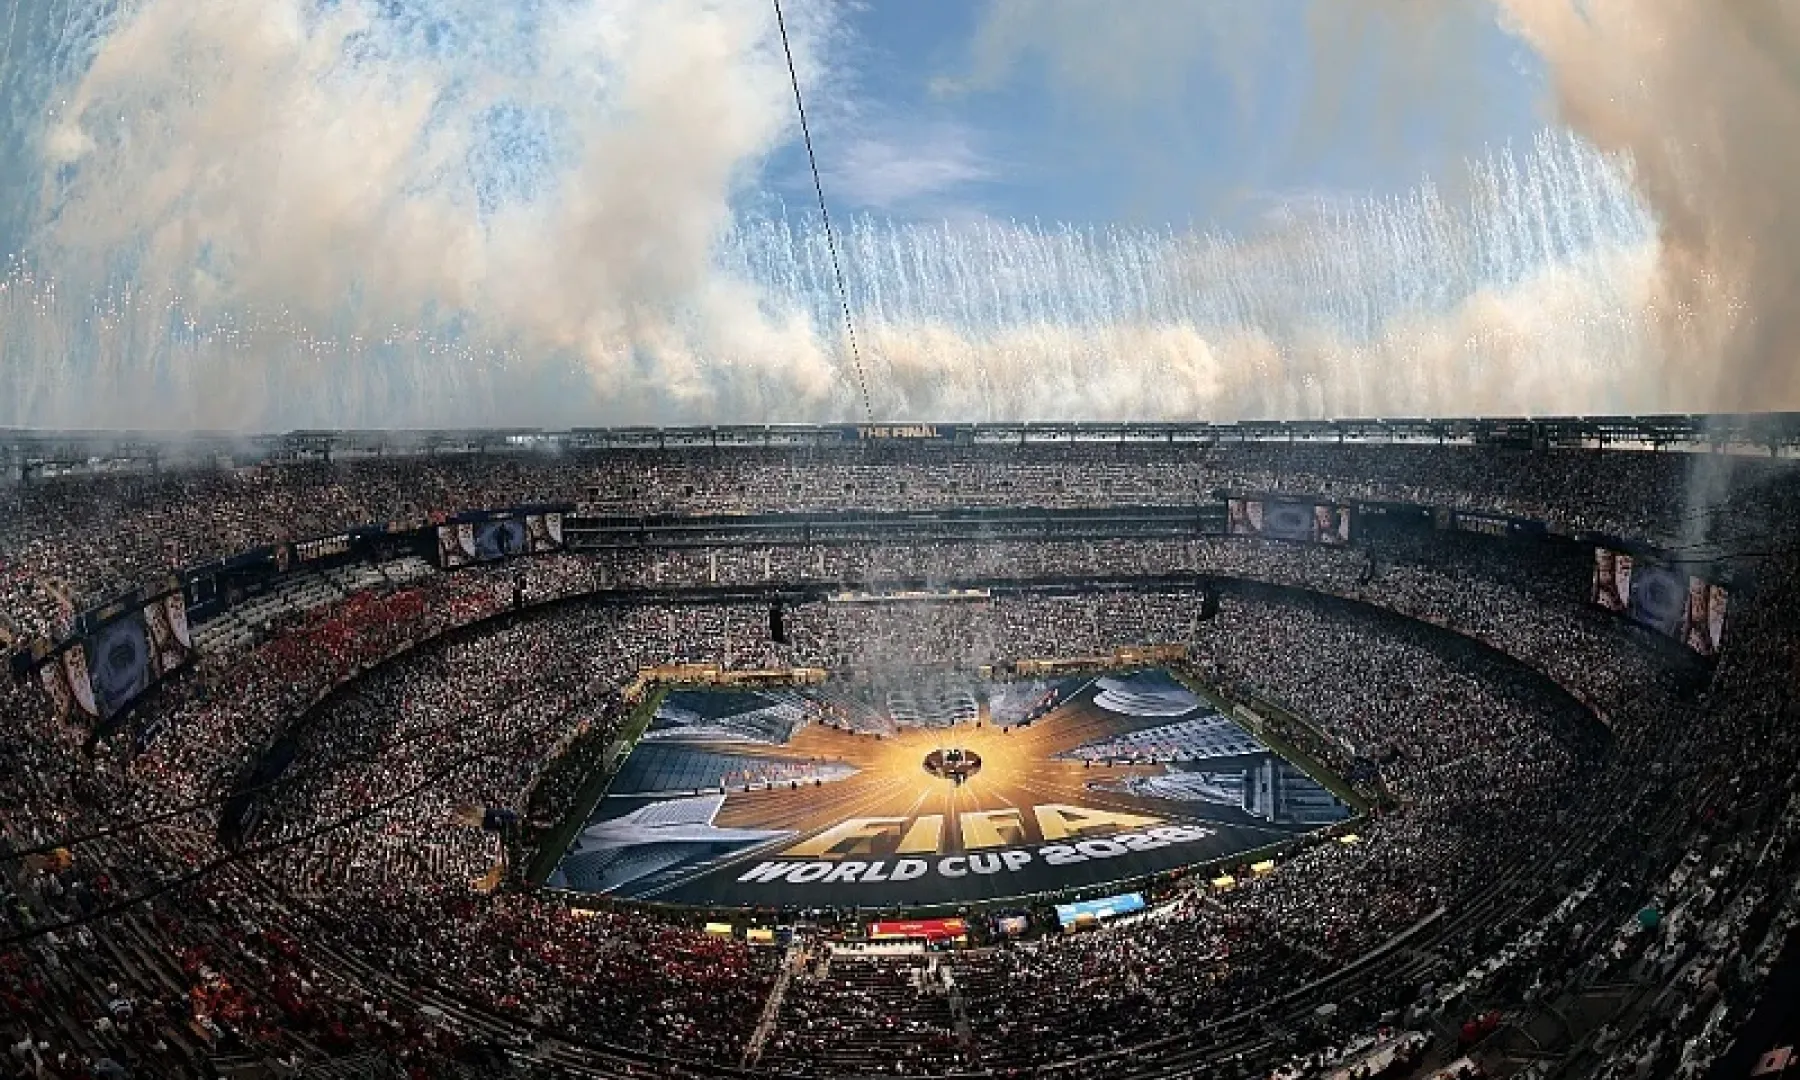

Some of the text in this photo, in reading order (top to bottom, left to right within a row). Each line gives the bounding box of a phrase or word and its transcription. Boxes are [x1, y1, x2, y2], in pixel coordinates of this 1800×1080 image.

[781, 805, 1170, 855] FIFA
[737, 859, 928, 883] WORLD
[937, 850, 1032, 878] CUP
